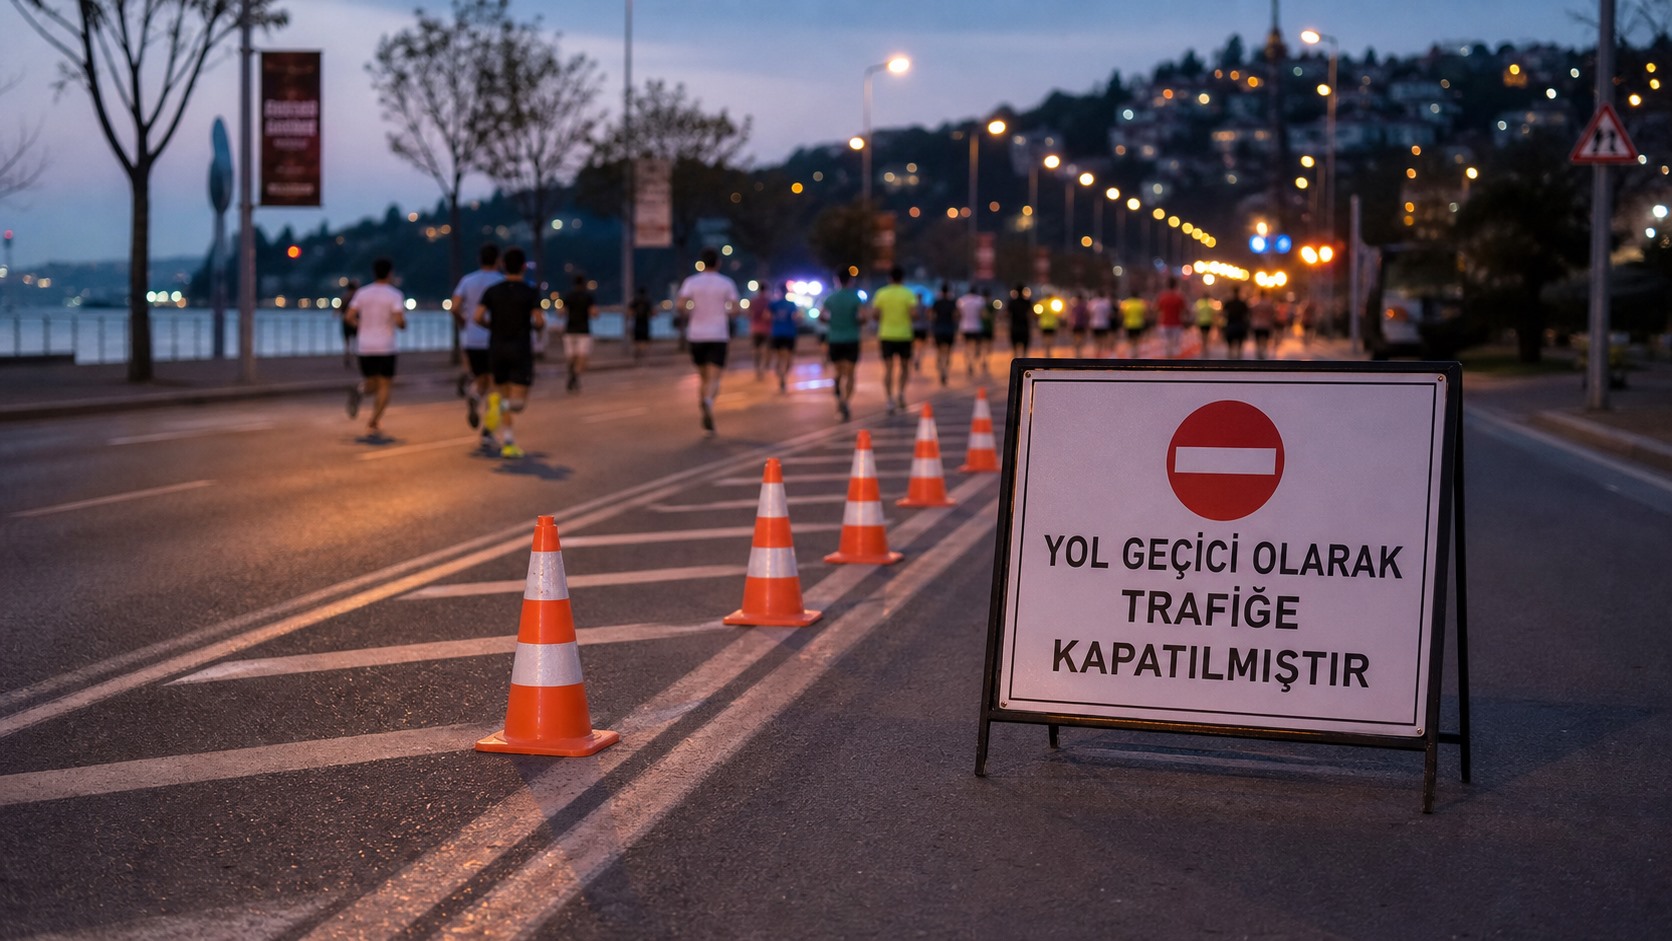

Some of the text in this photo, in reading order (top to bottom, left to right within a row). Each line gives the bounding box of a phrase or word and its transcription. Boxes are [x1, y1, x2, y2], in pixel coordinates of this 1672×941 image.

[1044, 532, 1404, 580] YOL GEÇİCİ OLARAK
[1121, 585, 1300, 630] TRAFİĞE
[1052, 638, 1370, 693] KAPATILMIŞTIR
